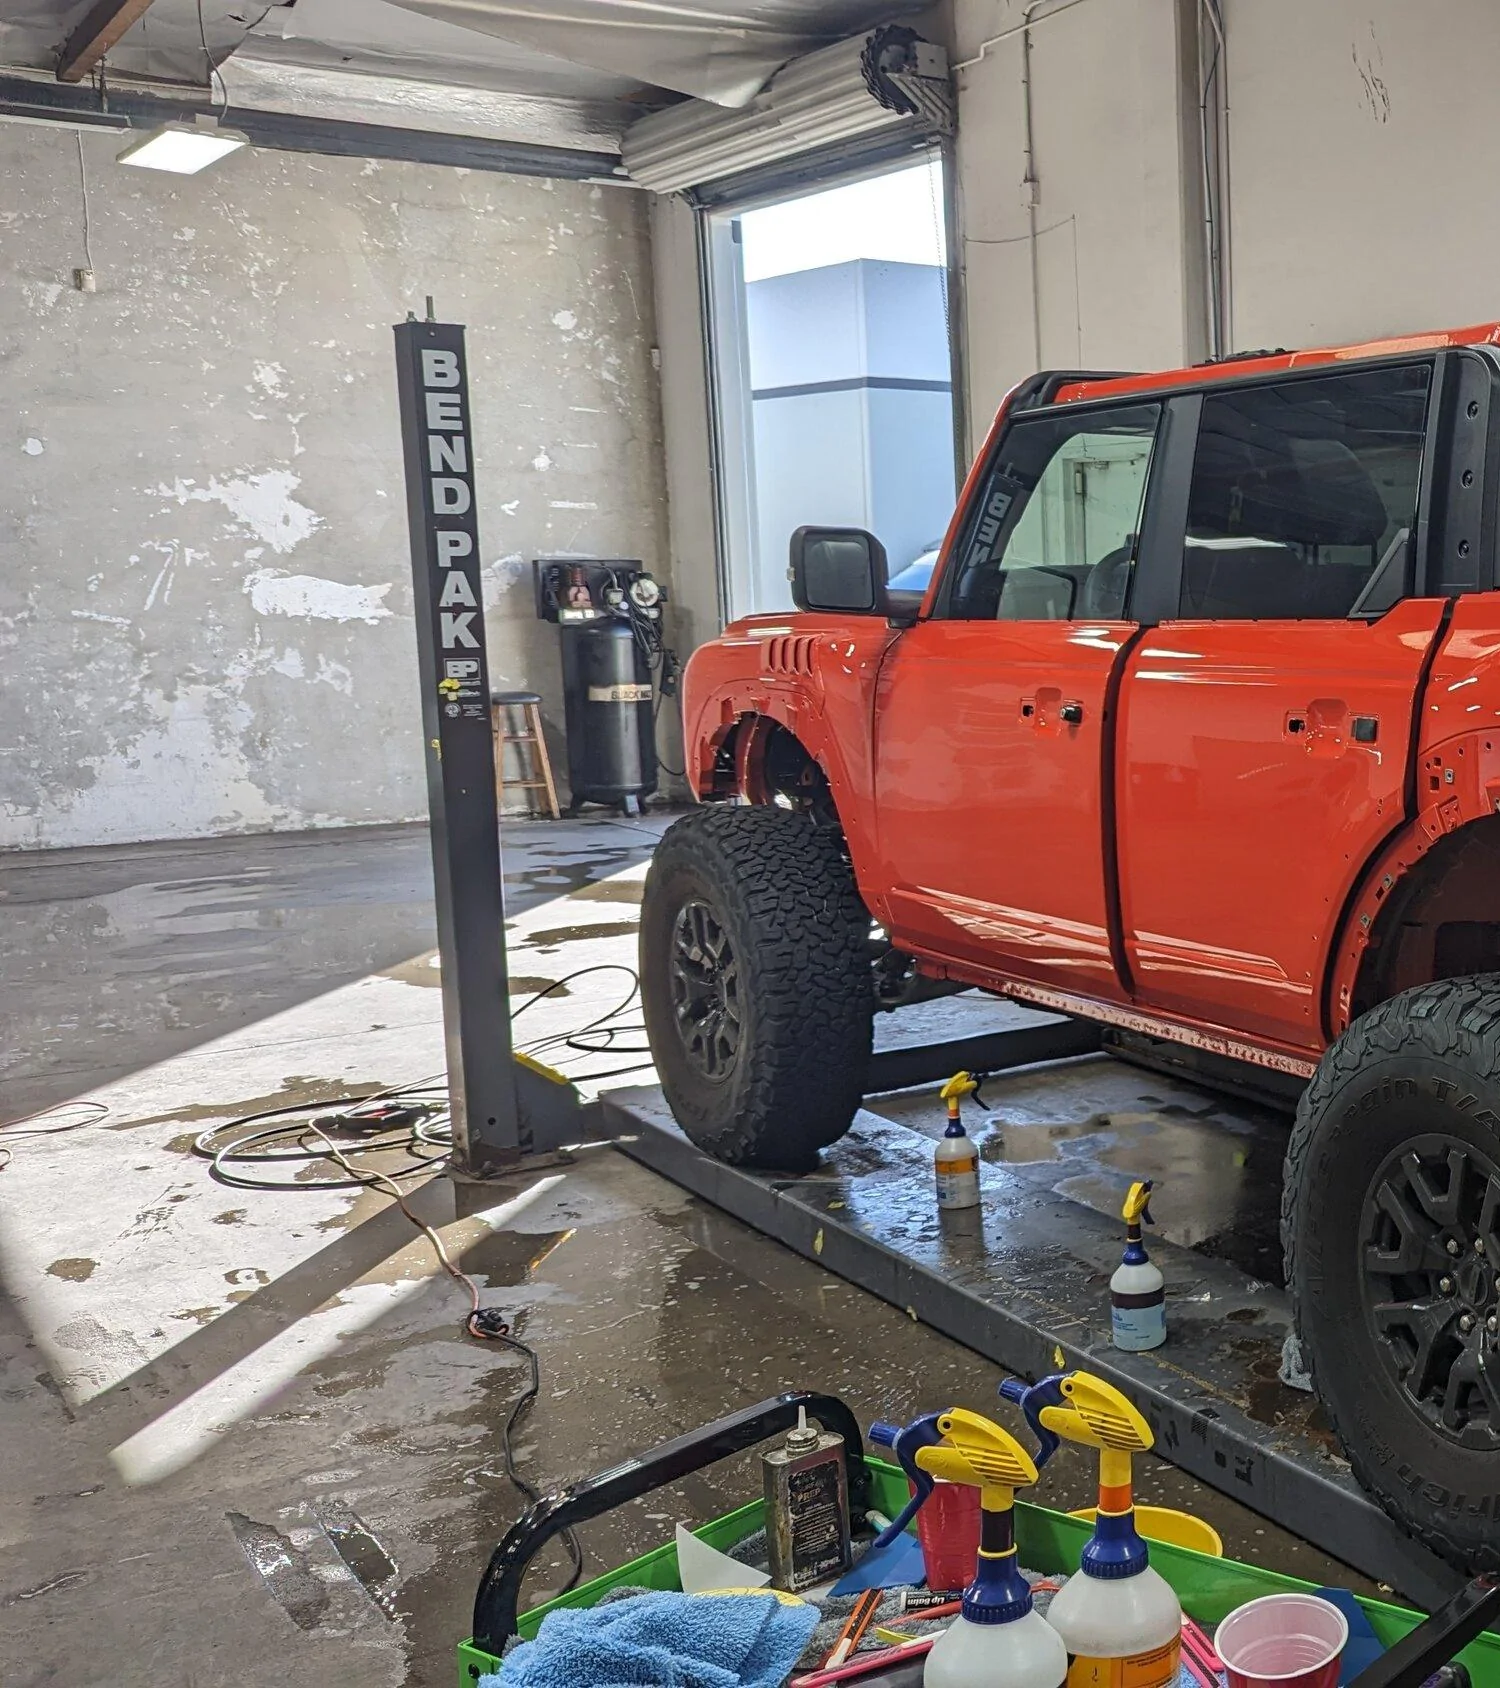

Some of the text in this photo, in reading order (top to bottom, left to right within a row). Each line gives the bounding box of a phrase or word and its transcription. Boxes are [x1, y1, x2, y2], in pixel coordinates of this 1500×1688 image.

[446, 660, 478, 678] BP
[907, 1596, 945, 1607] Lip Balm
